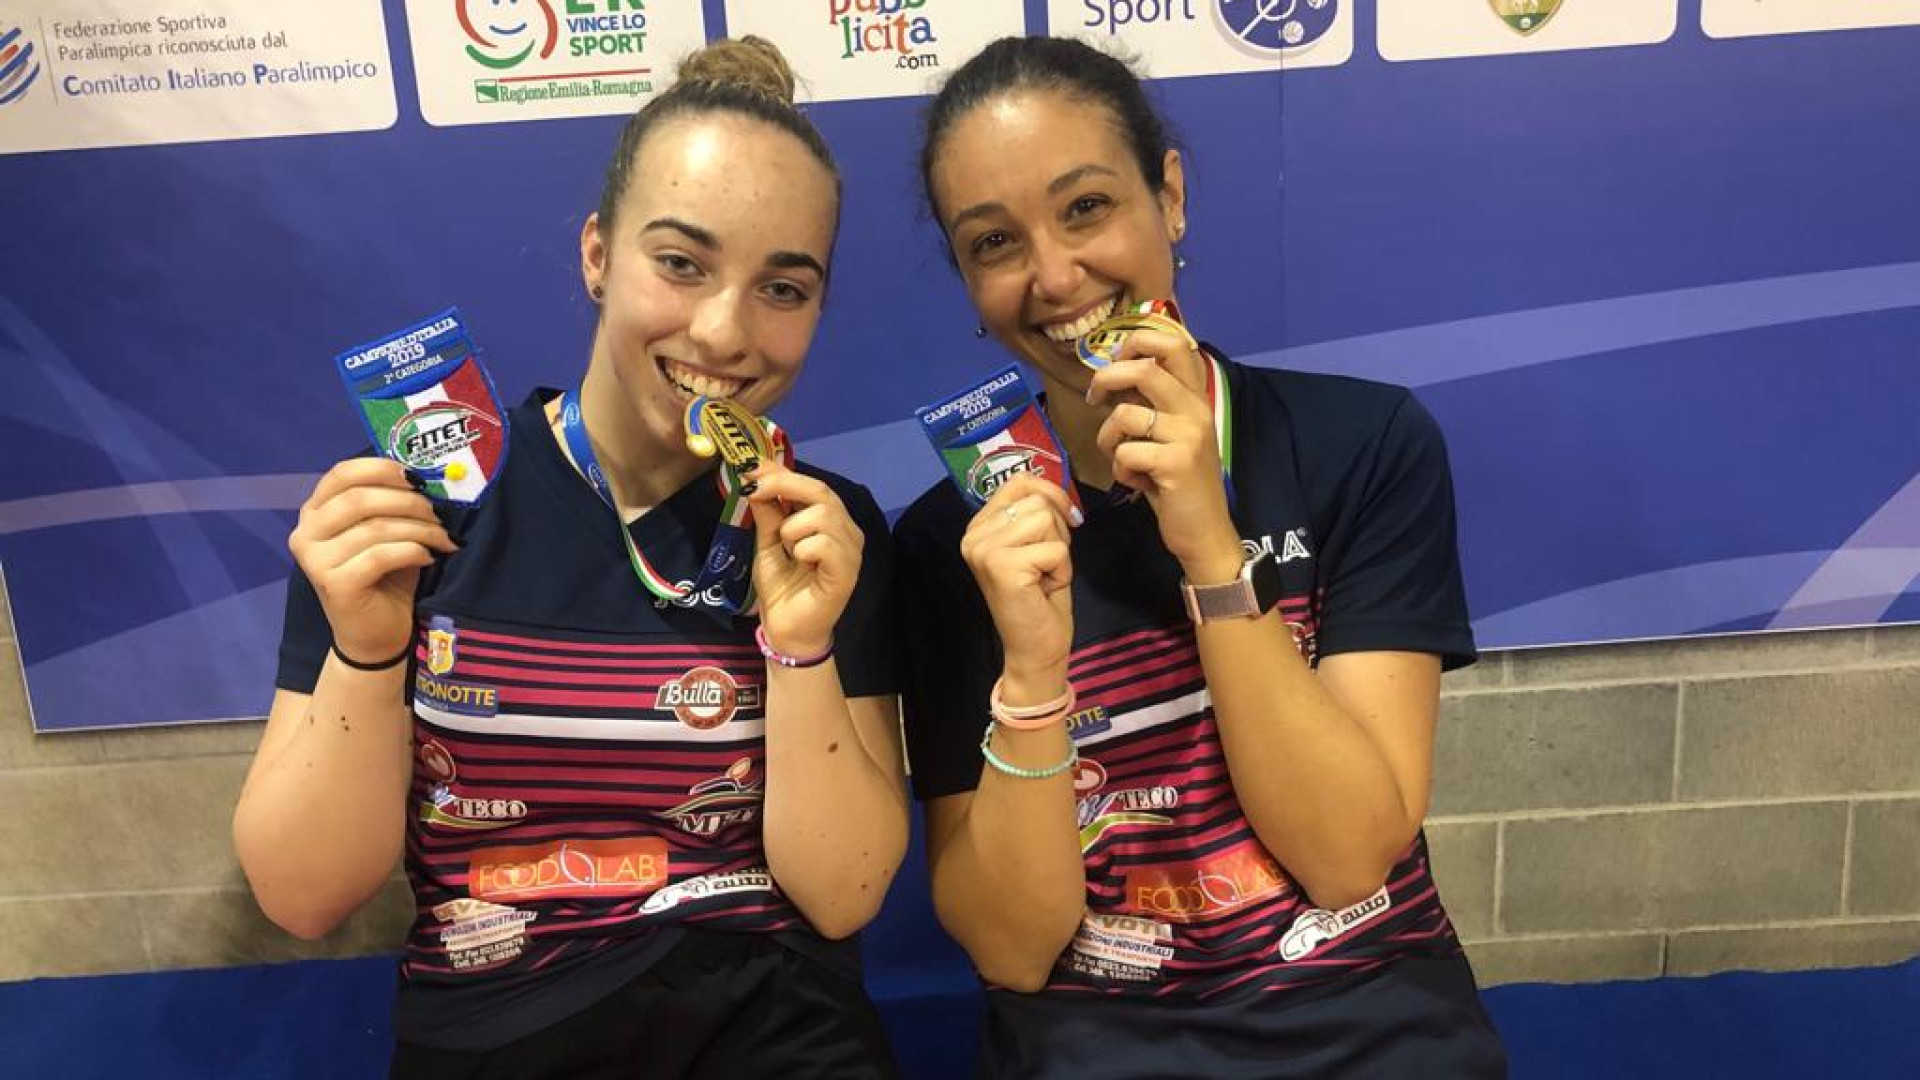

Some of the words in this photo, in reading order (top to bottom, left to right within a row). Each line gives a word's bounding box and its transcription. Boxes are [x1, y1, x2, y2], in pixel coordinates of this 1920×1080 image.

[54, 22, 152, 38] Federazione
[157, 16, 227, 36] Sportiva
[566, 15, 619, 33] VINCE
[622, 14, 646, 29] LO
[59, 44, 153, 62] Paralimpica
[159, 36, 256, 55] riconosciuta
[262, 31, 289, 48] dal
[570, 33, 647, 56] SPORT
[895, 54, 939, 70] .com
[63, 73, 161, 97] Comitato
[168, 68, 247, 90] Italiano
[254, 59, 377, 83] Paralimpico
[388, 344, 425, 367] 2019
[406, 417, 468, 454] FITET
[665, 681, 721, 704] Bulla
[453, 799, 527, 818] TECO
[598, 855, 657, 883] LAB
[1340, 895, 1386, 924] auto
